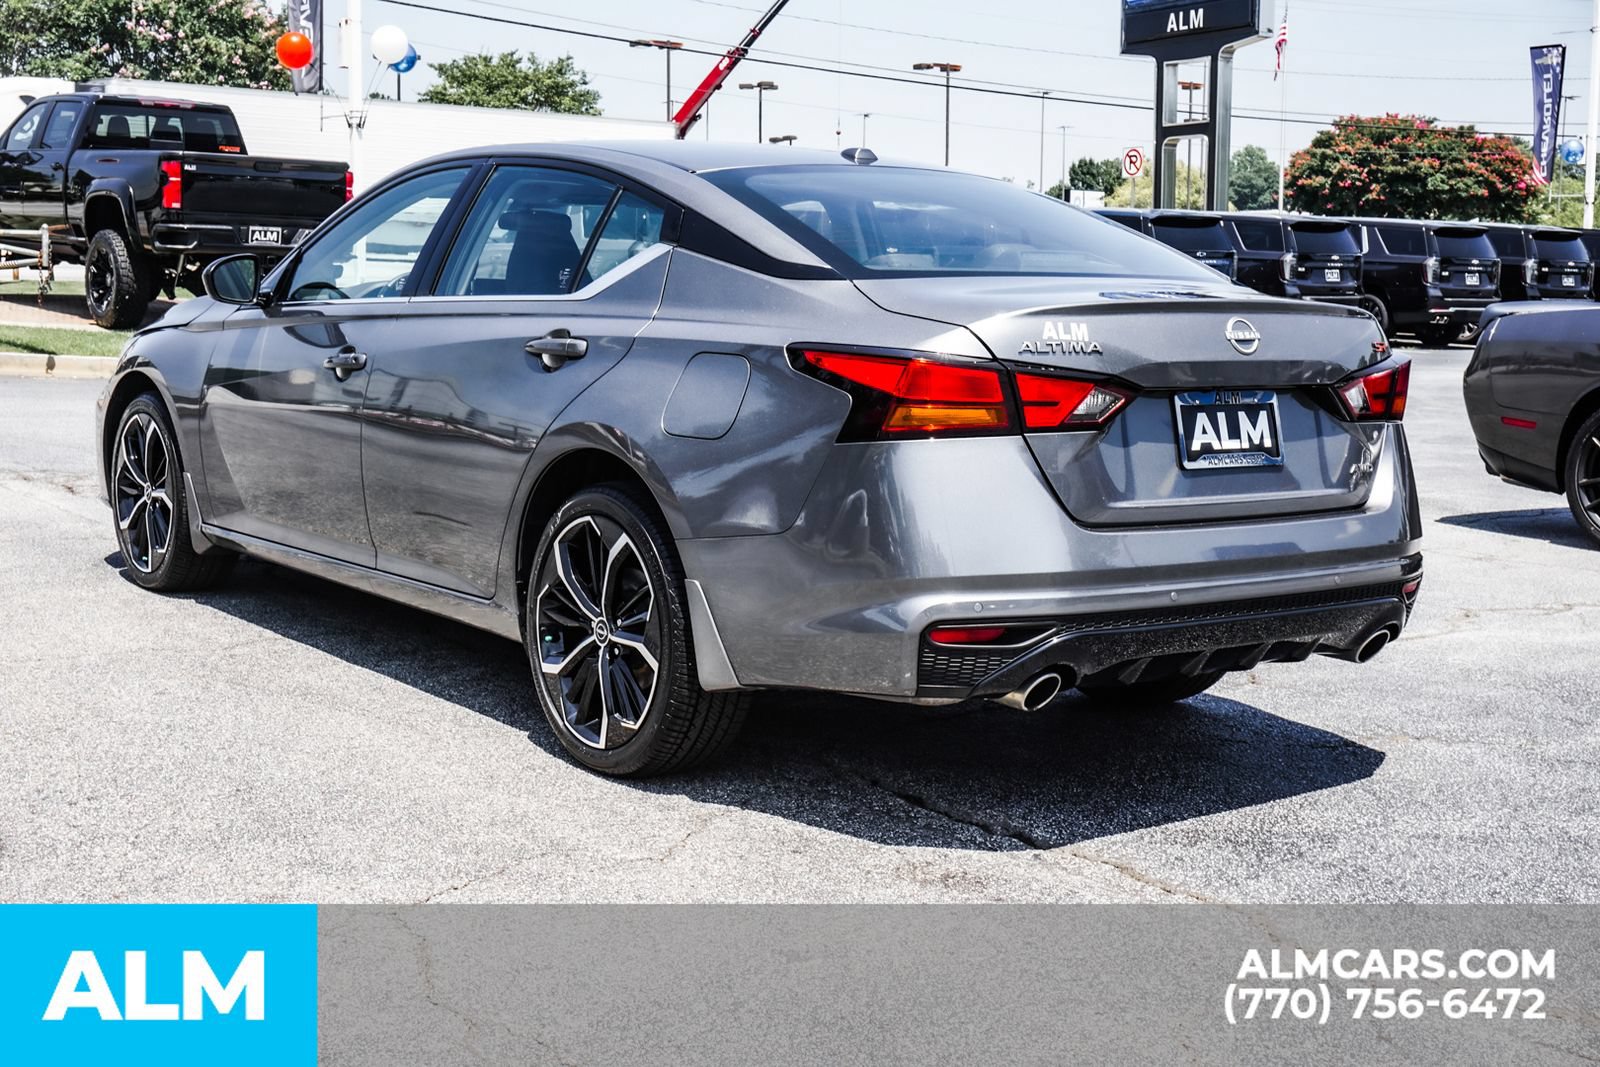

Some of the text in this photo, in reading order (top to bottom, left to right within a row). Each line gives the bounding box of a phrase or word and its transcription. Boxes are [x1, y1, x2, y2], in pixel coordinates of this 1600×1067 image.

[1166, 8, 1204, 33] ALM
[252, 230, 278, 241] ALM
[1042, 321, 1089, 341] ALM
[1224, 330, 1261, 340] NISSAN
[1018, 341, 1103, 356] ALTIMA
[1215, 391, 1241, 405] ALM
[1191, 410, 1273, 451] ALM
[1208, 454, 1263, 465] ALMCARS.COM
